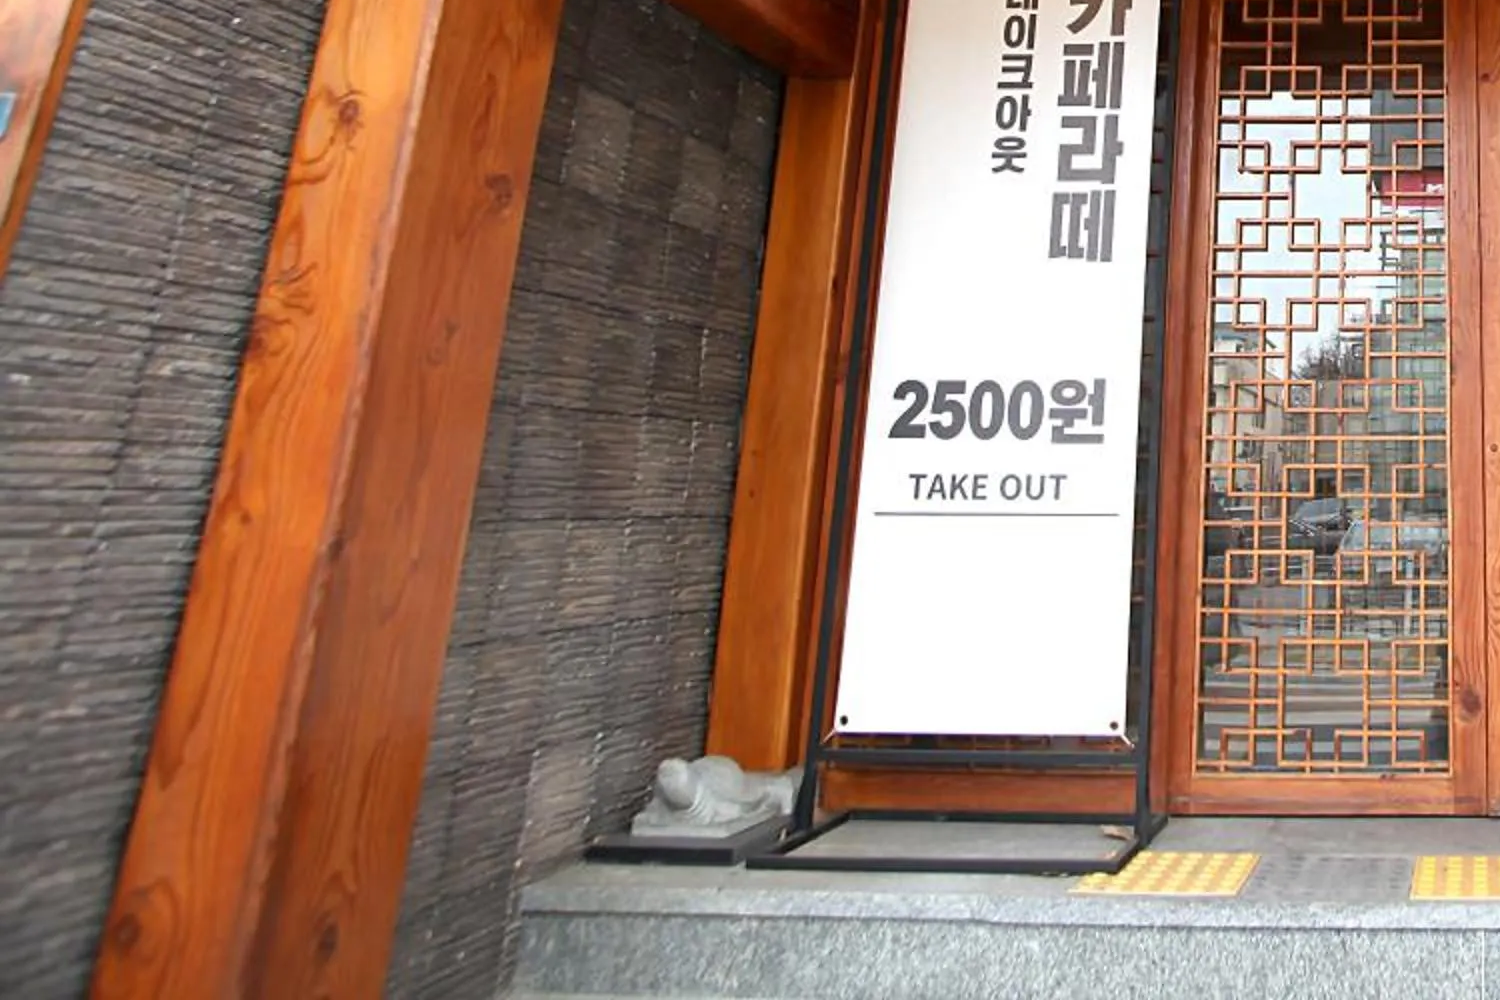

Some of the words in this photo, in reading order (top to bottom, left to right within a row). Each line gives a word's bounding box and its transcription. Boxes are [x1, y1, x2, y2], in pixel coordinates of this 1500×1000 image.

[887, 378, 1106, 444] 2500원
[908, 473, 988, 501] TAKE
[999, 473, 1068, 501] OUT
